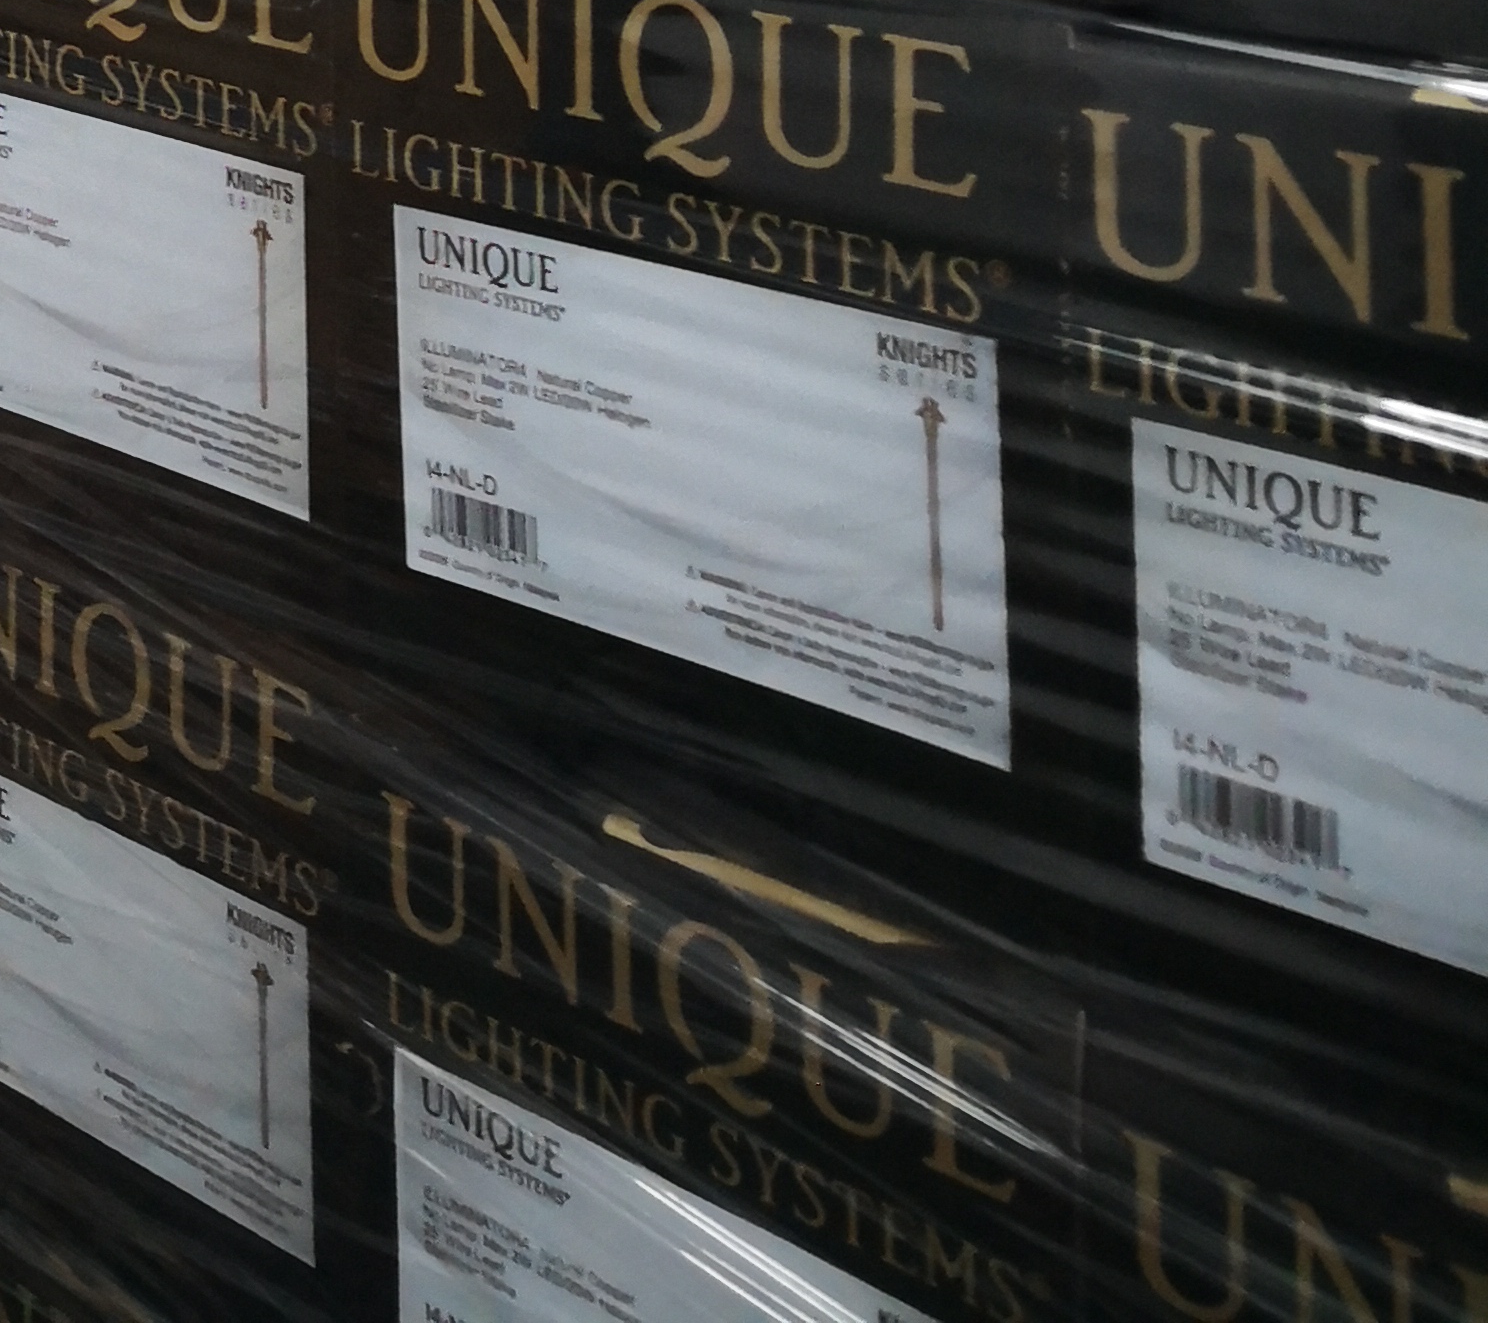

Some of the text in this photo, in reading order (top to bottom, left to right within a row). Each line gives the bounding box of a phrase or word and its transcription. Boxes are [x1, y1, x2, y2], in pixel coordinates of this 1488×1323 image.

[225, 165, 294, 205] KNIGHTS
[350, 119, 644, 244] LIGHTING
[1081, 108, 1470, 341] UNI
[417, 226, 560, 294] UNIQUE
[876, 331, 978, 379] KNIGHTS
[1165, 444, 1382, 541] UNIQUE
[381, 790, 1018, 1203] UNIQUE
[386, 971, 688, 1161] LIGHTING
[420, 1076, 563, 1179] UNIQUE
